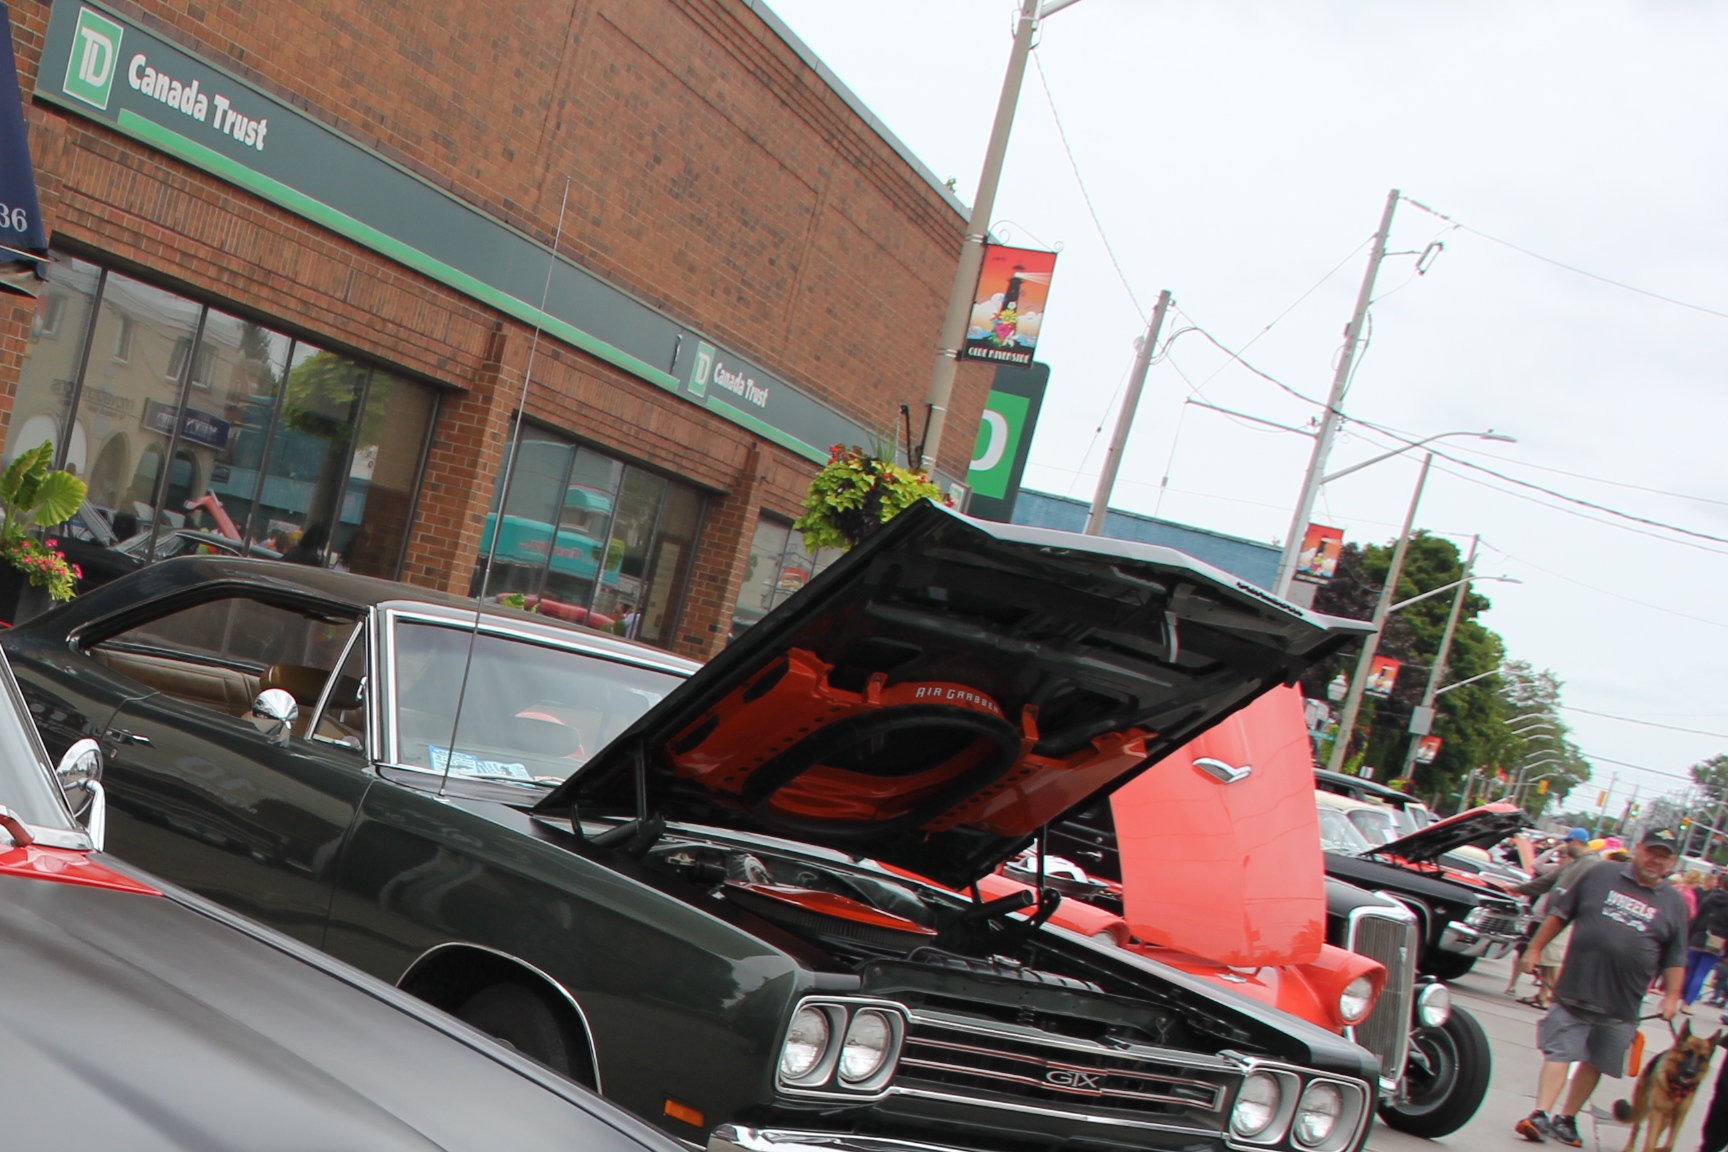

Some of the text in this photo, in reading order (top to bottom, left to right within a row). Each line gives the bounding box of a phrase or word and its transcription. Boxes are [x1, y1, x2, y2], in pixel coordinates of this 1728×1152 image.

[78, 26, 268, 151] TD Canada Trust
[713, 362, 746, 396] Canada
[745, 378, 769, 409] Trust
[915, 687, 943, 698] AIR
[1046, 1070, 1101, 1089] GTX
